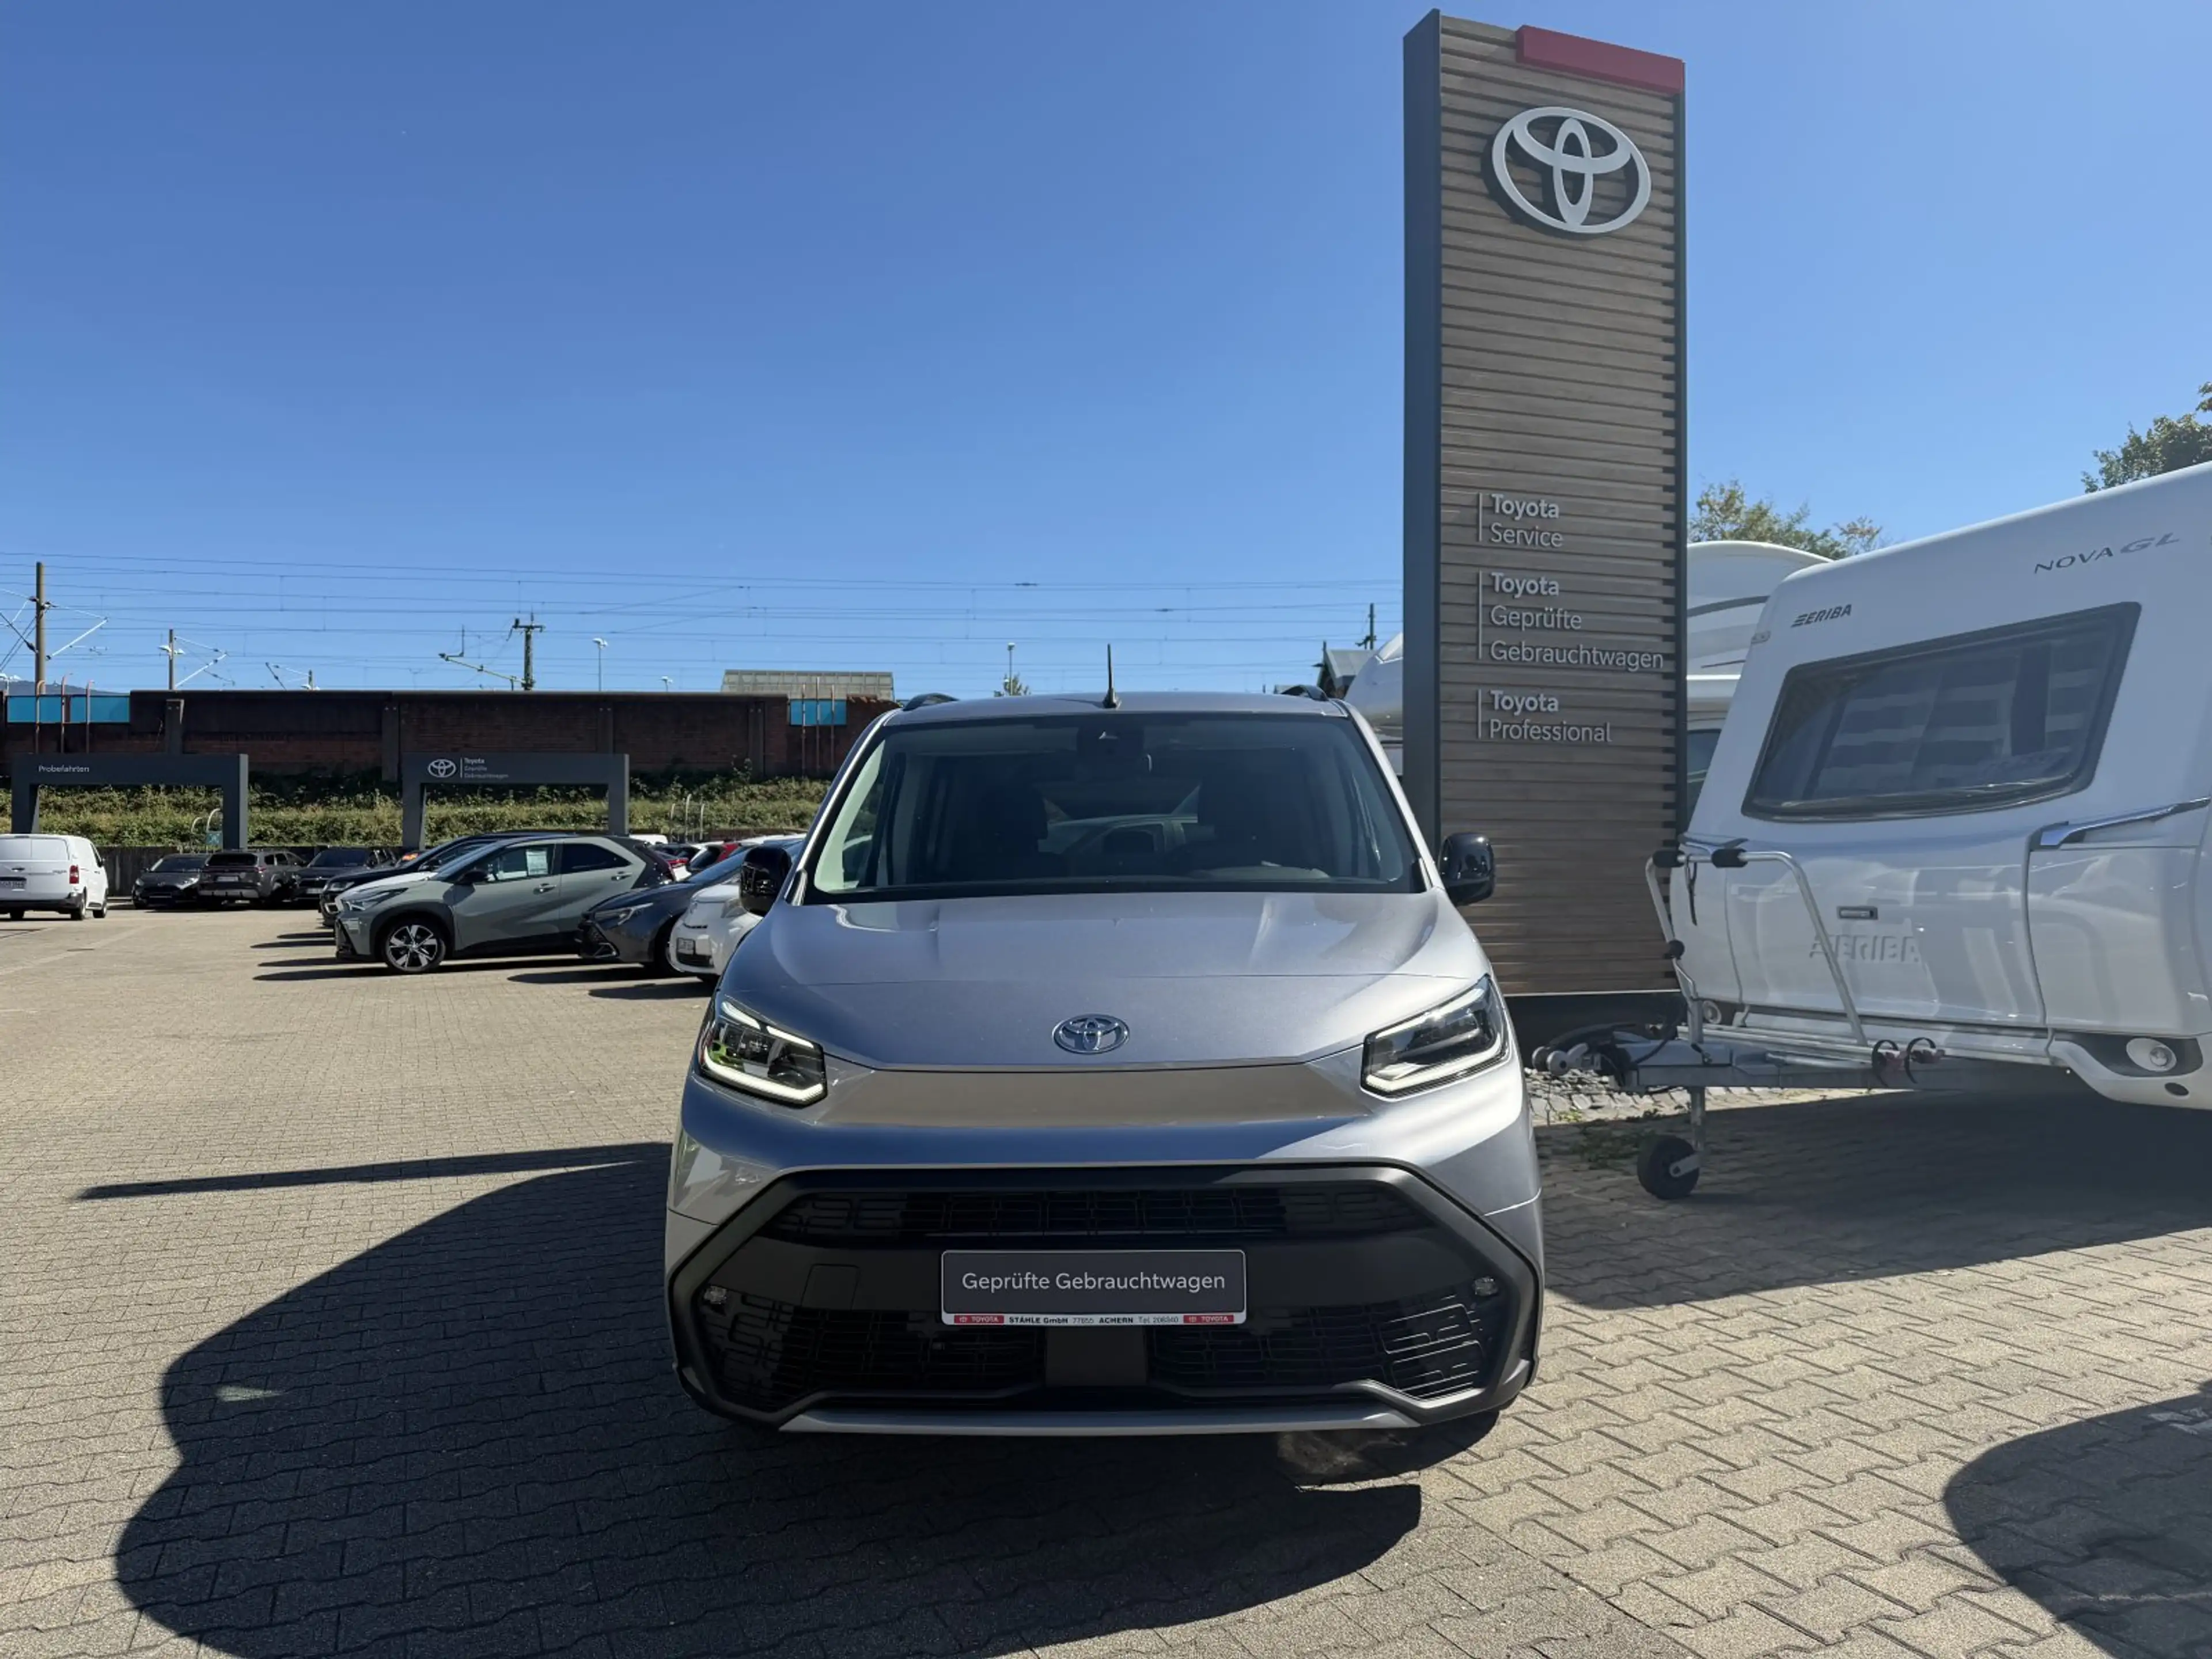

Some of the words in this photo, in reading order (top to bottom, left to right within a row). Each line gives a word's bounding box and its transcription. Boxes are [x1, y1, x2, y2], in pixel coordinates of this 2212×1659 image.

[1491, 493, 1560, 520] Toyota
[1490, 522, 1564, 547] Service
[2033, 546, 2114, 574] NOVA
[2120, 532, 2180, 554] GL
[1491, 572, 1560, 599] Toyota
[1490, 605, 1582, 631] Geprüfte
[1490, 639, 1664, 672] Gebrauchtwagen
[1490, 690, 1559, 716] Toyota
[1489, 719, 1613, 743] Professional
[38, 764, 90, 772] Probefahrten
[961, 1272, 1051, 1293] Geprüfte
[1055, 1272, 1226, 1293] Gebrauchtwagen
